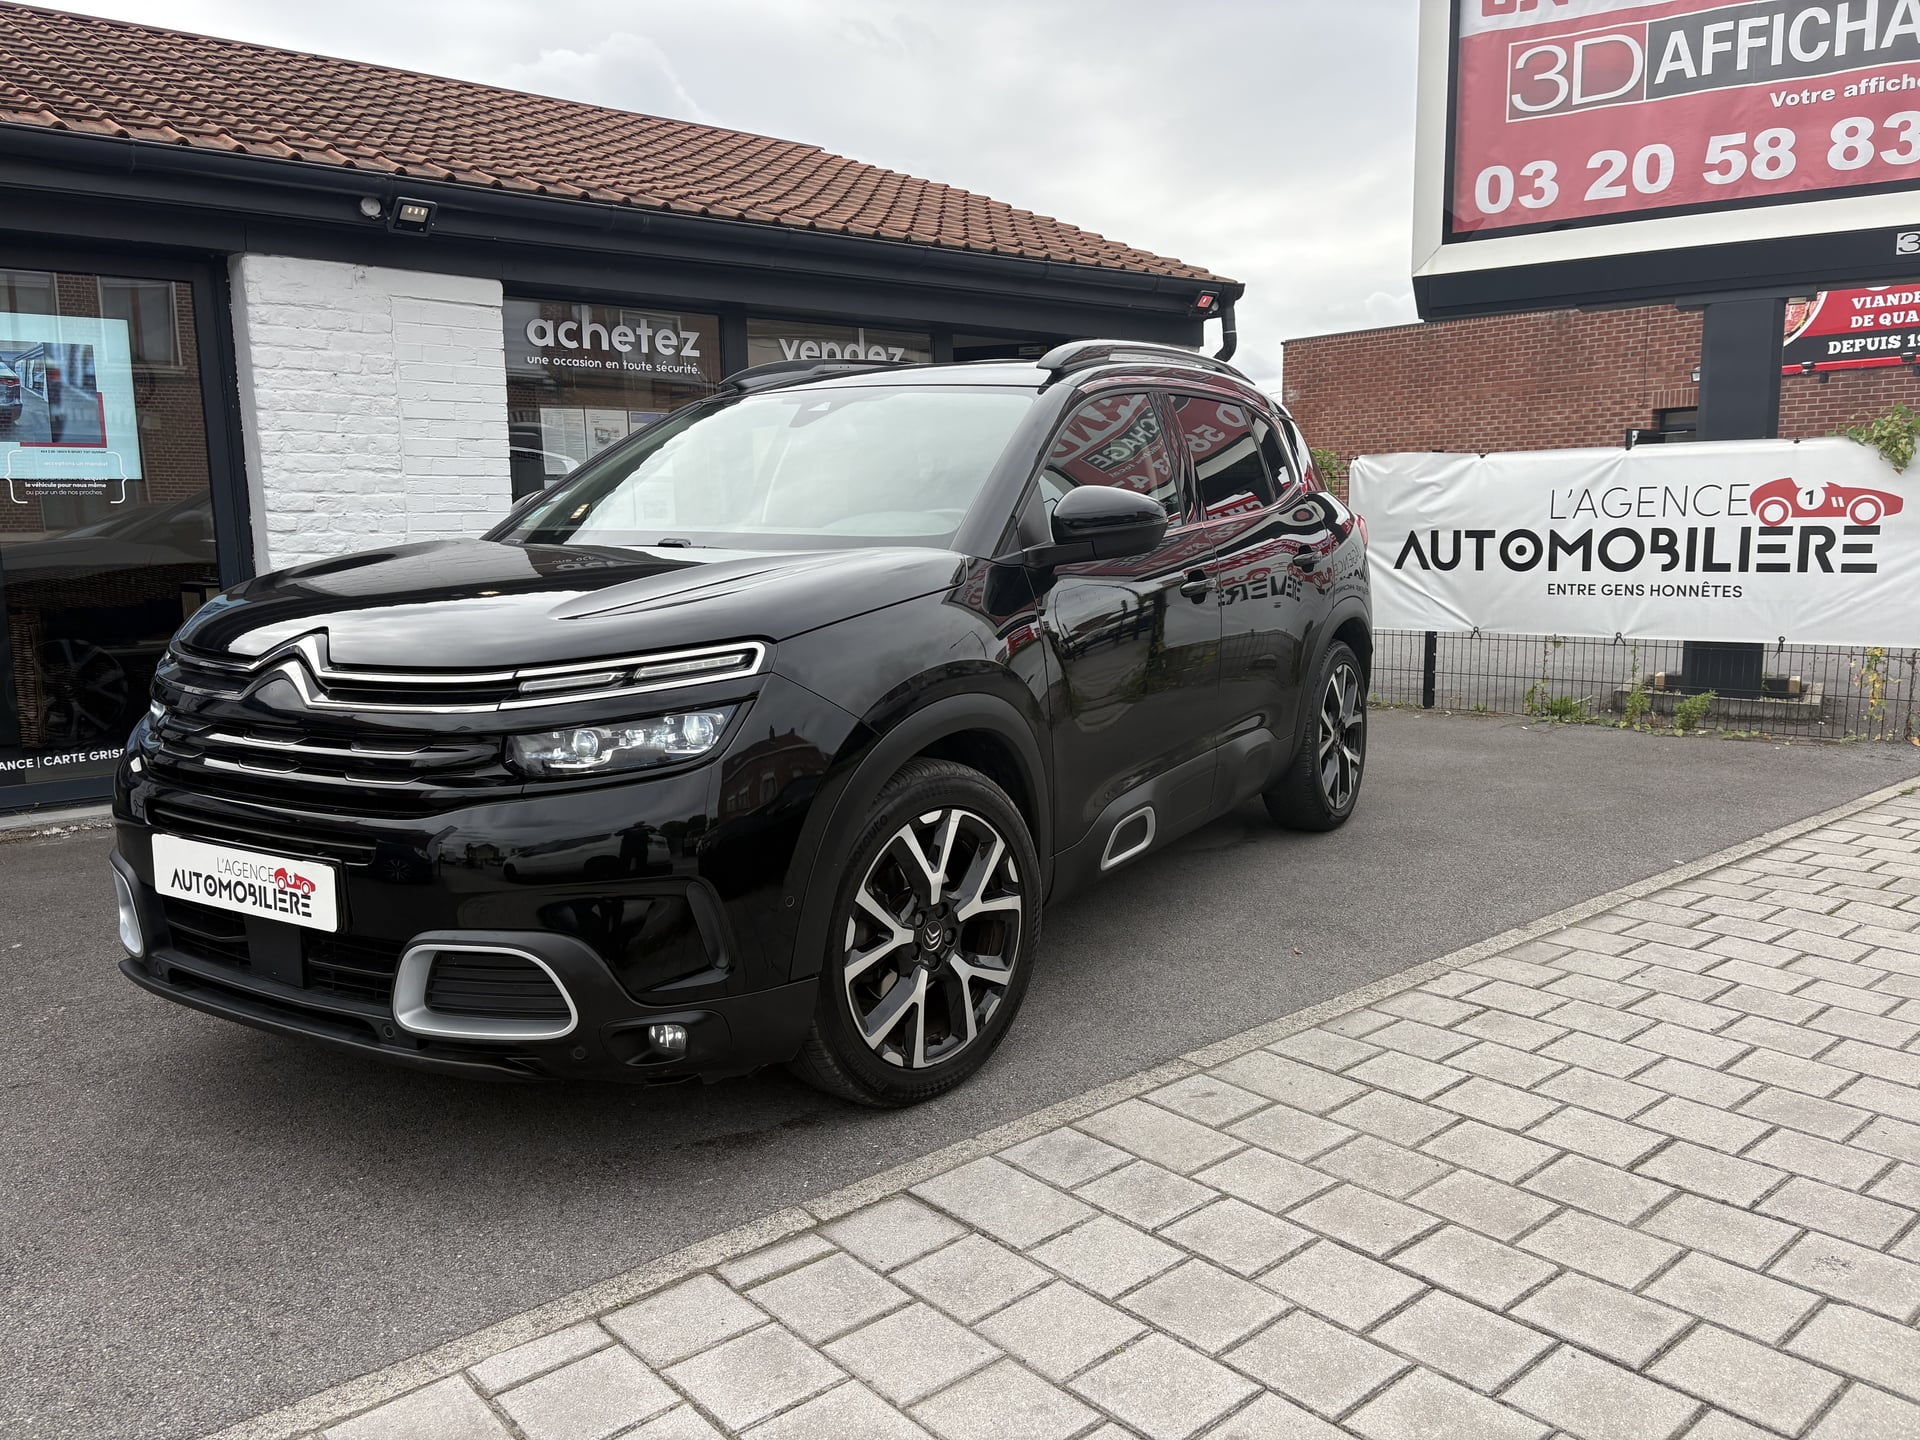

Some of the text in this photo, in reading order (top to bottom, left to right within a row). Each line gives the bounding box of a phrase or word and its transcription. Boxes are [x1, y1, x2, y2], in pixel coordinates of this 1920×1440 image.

[1510, 0, 1920, 112] 3D AFFICHA
[1770, 90, 1836, 109] Votre
[1474, 110, 1920, 214] 03 20 58 83
[526, 305, 700, 357] achetez
[1850, 315, 1875, 328] DE
[778, 327, 905, 362] vendez
[1827, 335, 1902, 355] DEPUIS
[527, 355, 701, 375] une occasion en toute sécurité.
[1550, 484, 1750, 520] L'AGENCE
[1547, 580, 1743, 598] ENTRE GENS HONNÊTES
[43, 752, 87, 766] CARTE
[216, 856, 276, 884] L'AGENCE
